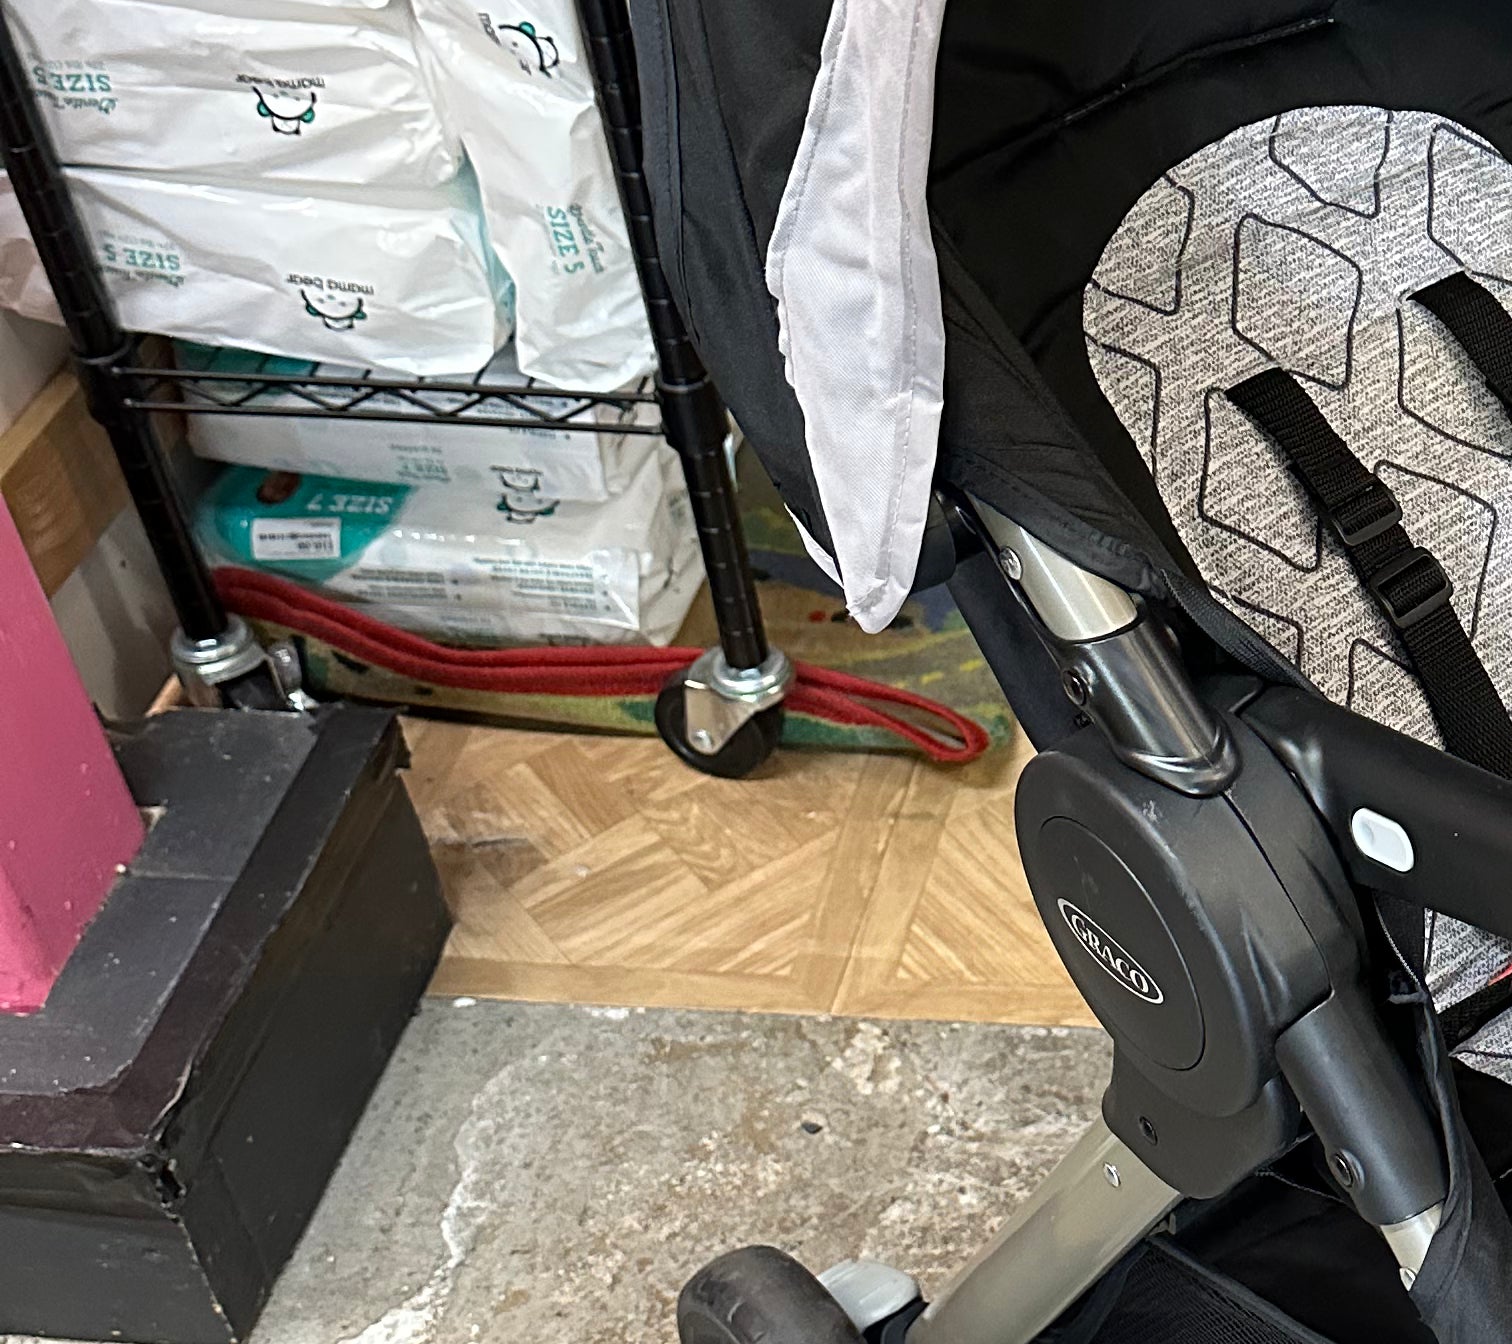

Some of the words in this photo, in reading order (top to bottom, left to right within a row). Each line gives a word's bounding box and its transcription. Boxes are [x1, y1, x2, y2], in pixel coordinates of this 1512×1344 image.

[49, 71, 112, 94] SIZE
[275, 77, 326, 90] mama
[546, 205, 580, 257] SIZE
[563, 261, 586, 274] 5
[101, 243, 118, 262] 5
[122, 248, 181, 272] SIZE
[287, 273, 324, 291] bear
[327, 278, 375, 295] mama
[328, 494, 393, 514] SIZE
[1072, 914, 1149, 994] GRACO
